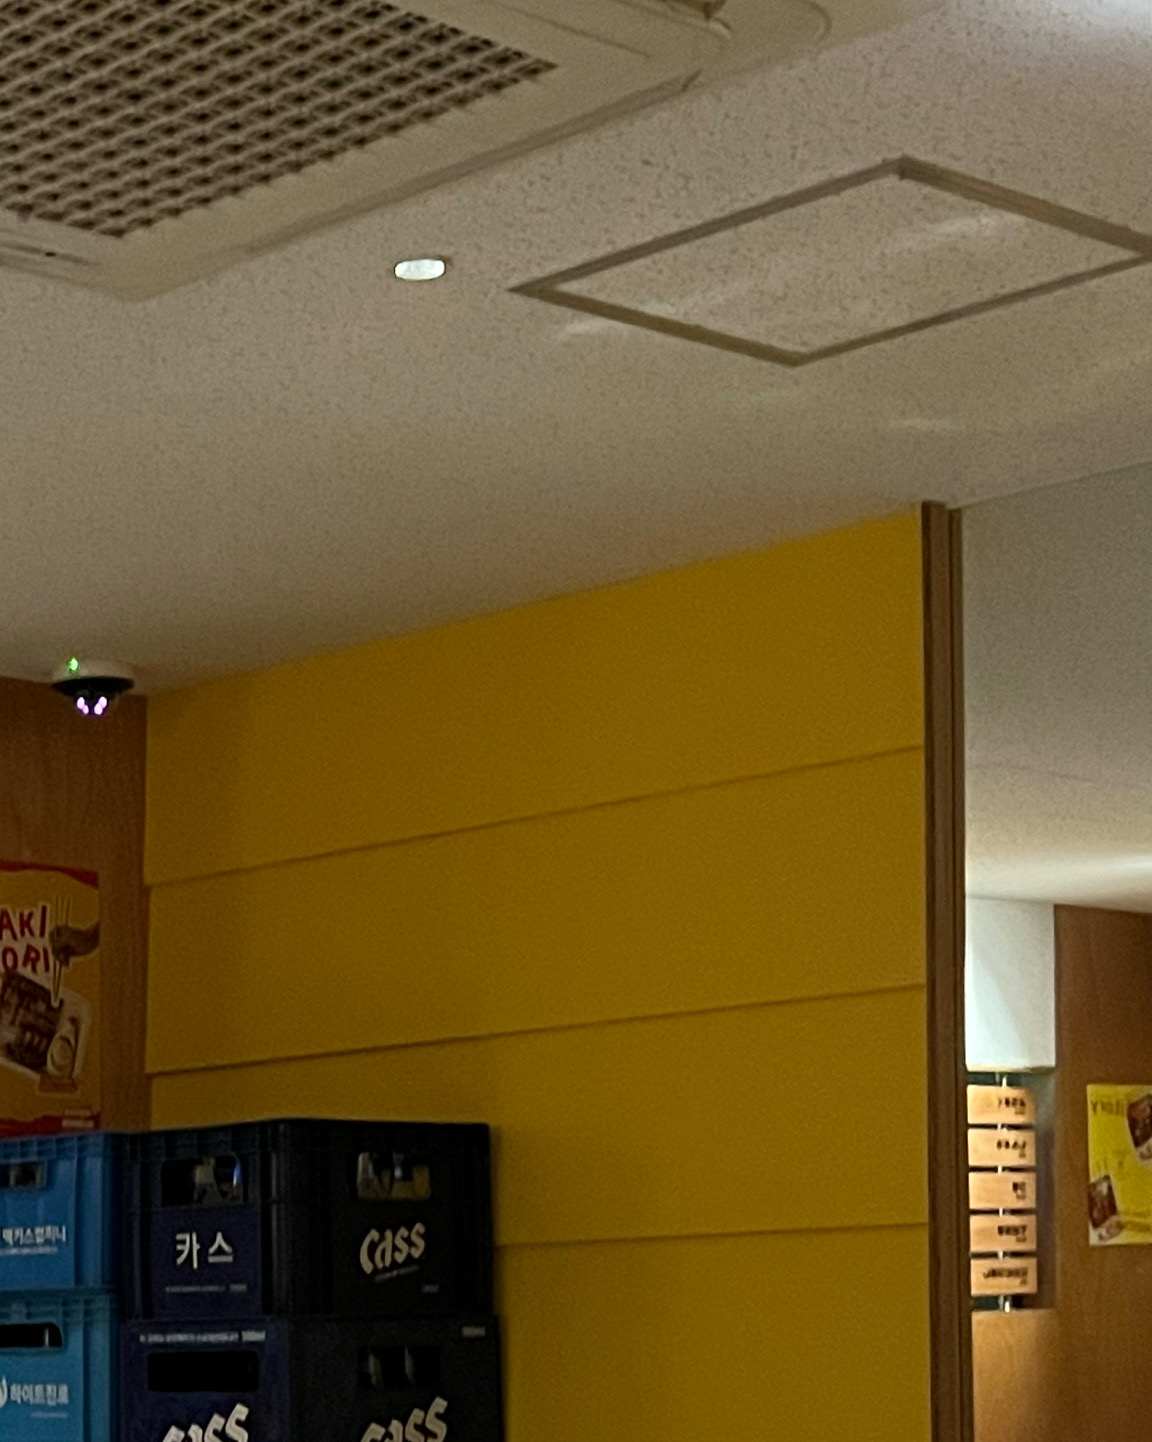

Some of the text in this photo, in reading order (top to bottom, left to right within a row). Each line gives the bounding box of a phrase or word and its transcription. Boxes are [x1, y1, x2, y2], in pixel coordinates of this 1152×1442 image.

[175, 1231, 234, 1271] 카스
[359, 1221, 426, 1275] Cass
[10, 1383, 70, 1407] 하이트진로
